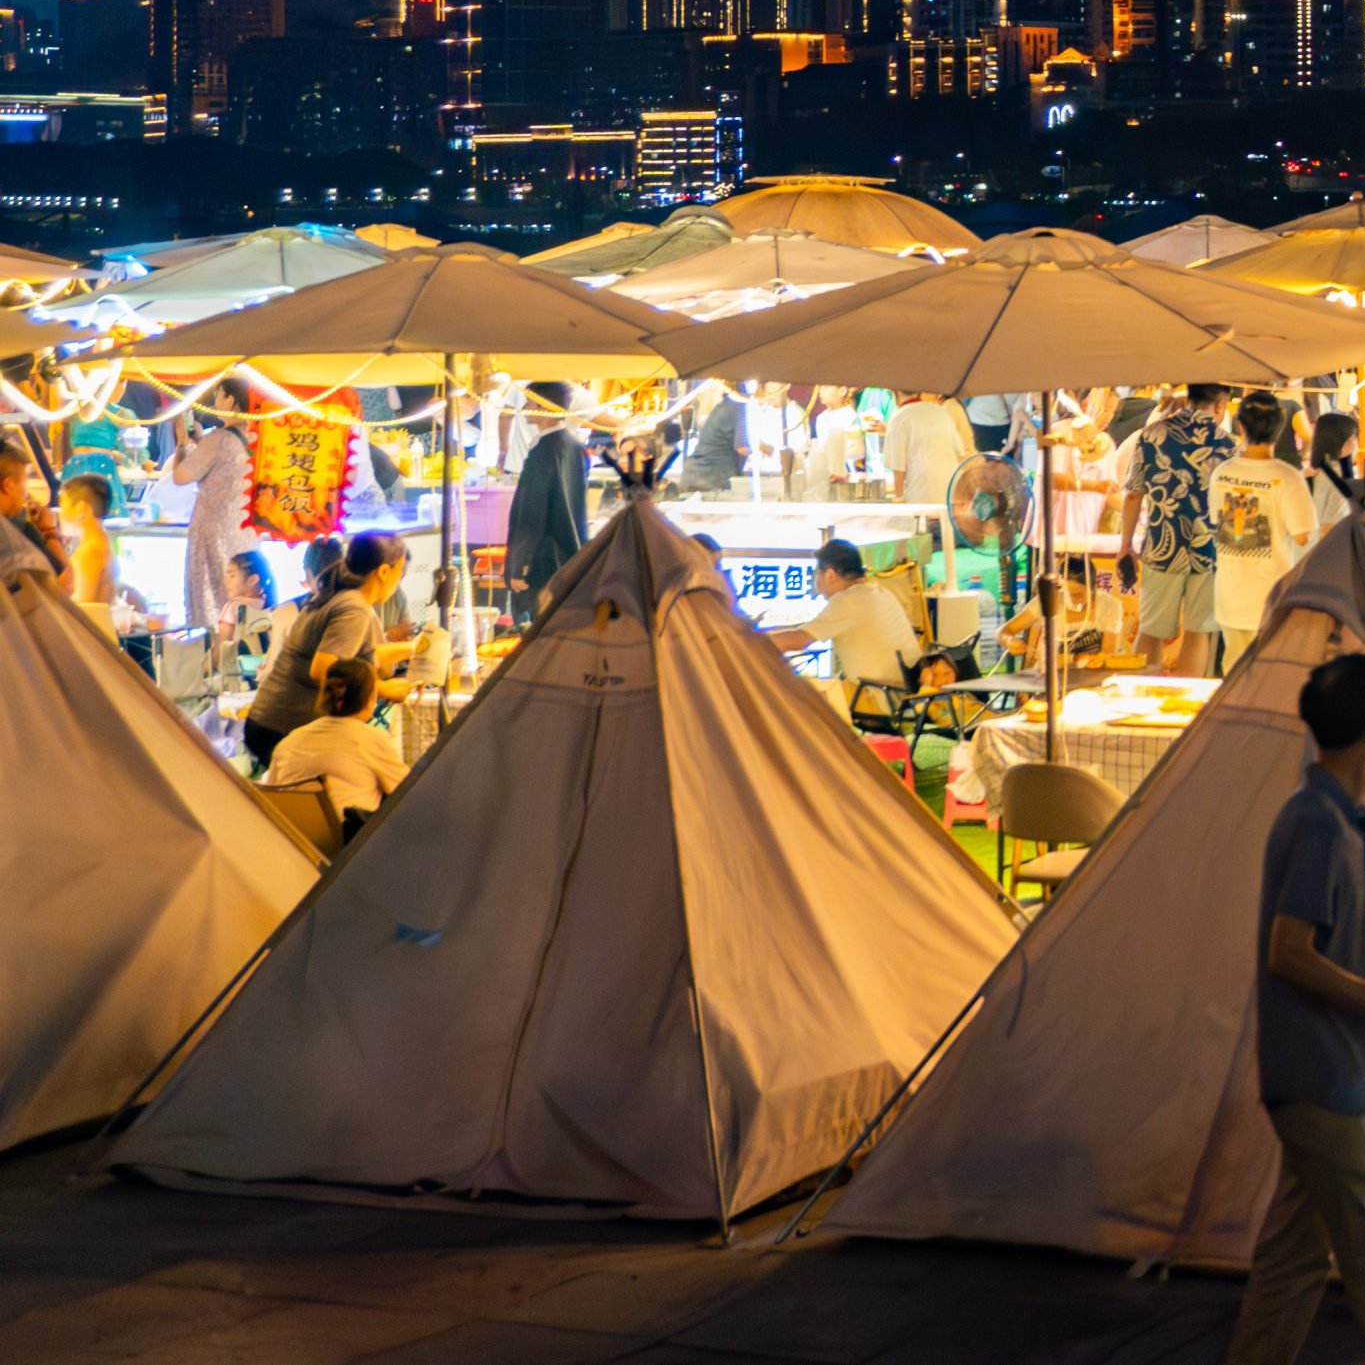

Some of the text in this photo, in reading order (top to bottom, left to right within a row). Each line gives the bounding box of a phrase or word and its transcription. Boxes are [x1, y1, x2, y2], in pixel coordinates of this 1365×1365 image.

[278, 432, 321, 514] 鸡翅包饭
[1218, 475, 1272, 490] McLaren
